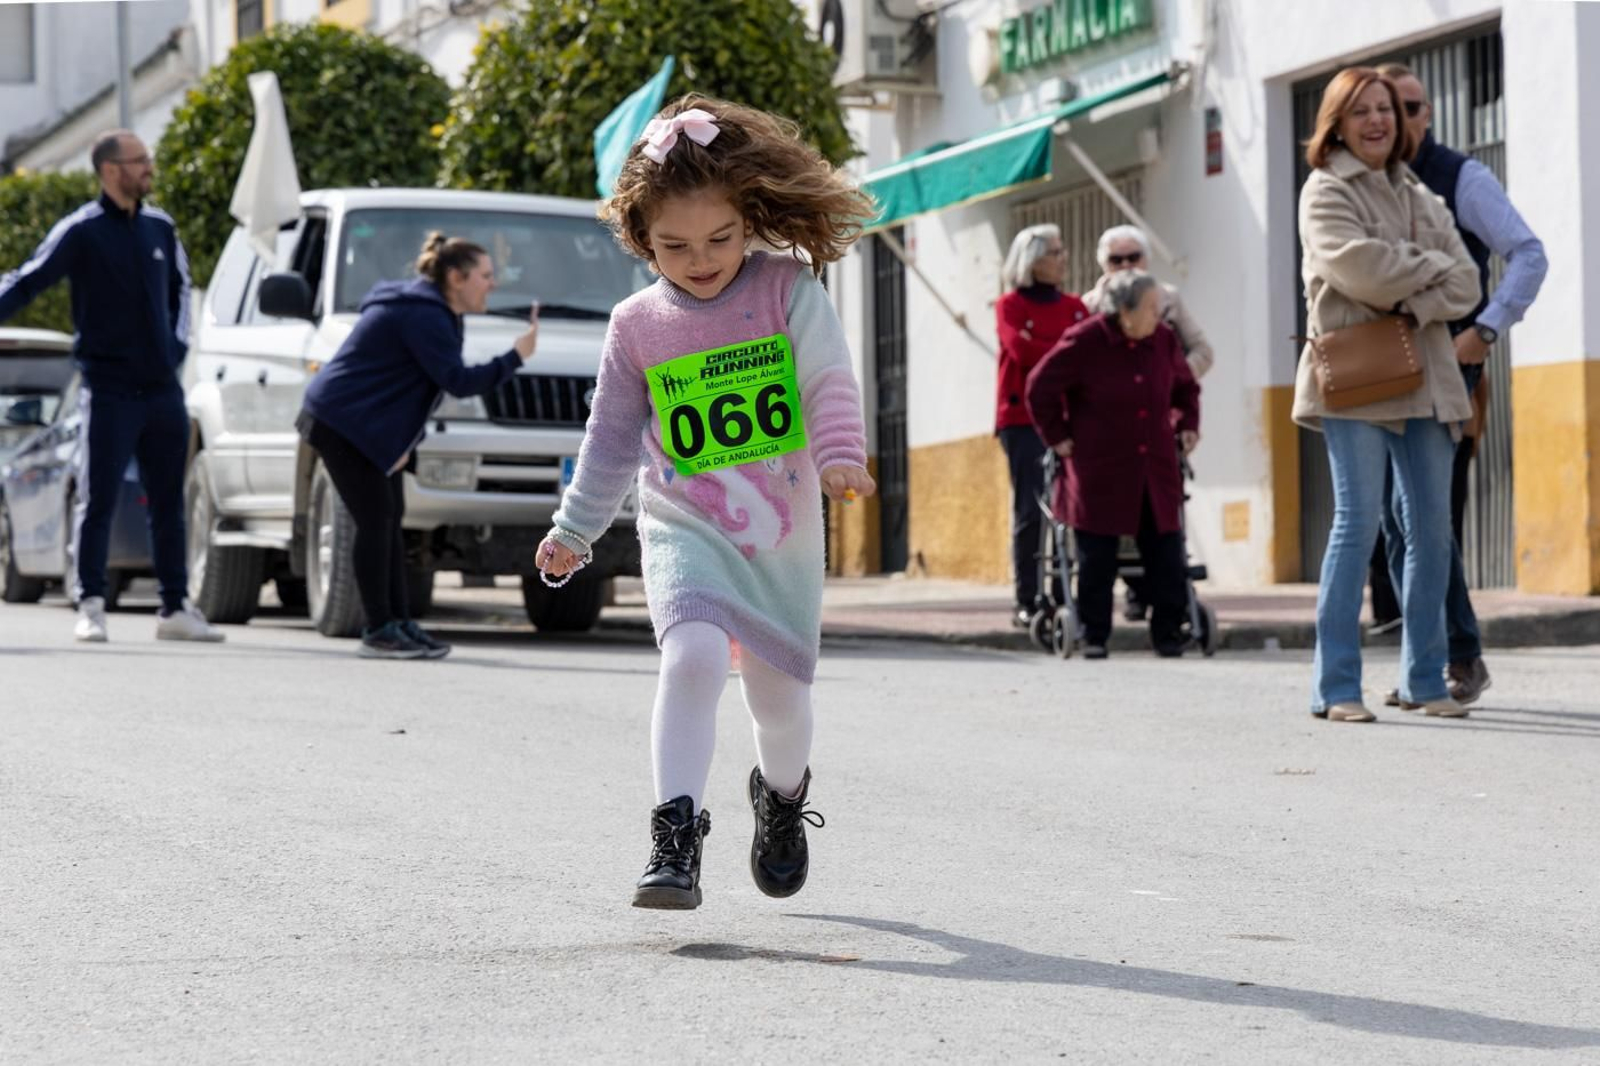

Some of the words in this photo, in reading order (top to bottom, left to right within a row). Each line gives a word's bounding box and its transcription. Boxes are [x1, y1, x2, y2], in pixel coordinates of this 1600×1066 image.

[700, 350, 785, 379] RUNNING
[706, 340, 778, 364] CIRCUITO
[706, 376, 734, 390] Monte
[736, 373, 757, 385] Lope
[669, 383, 792, 459] 066
[696, 456, 712, 469] DÍA
[713, 454, 727, 465] DE
[728, 443, 780, 463] ANDALUCÍA
